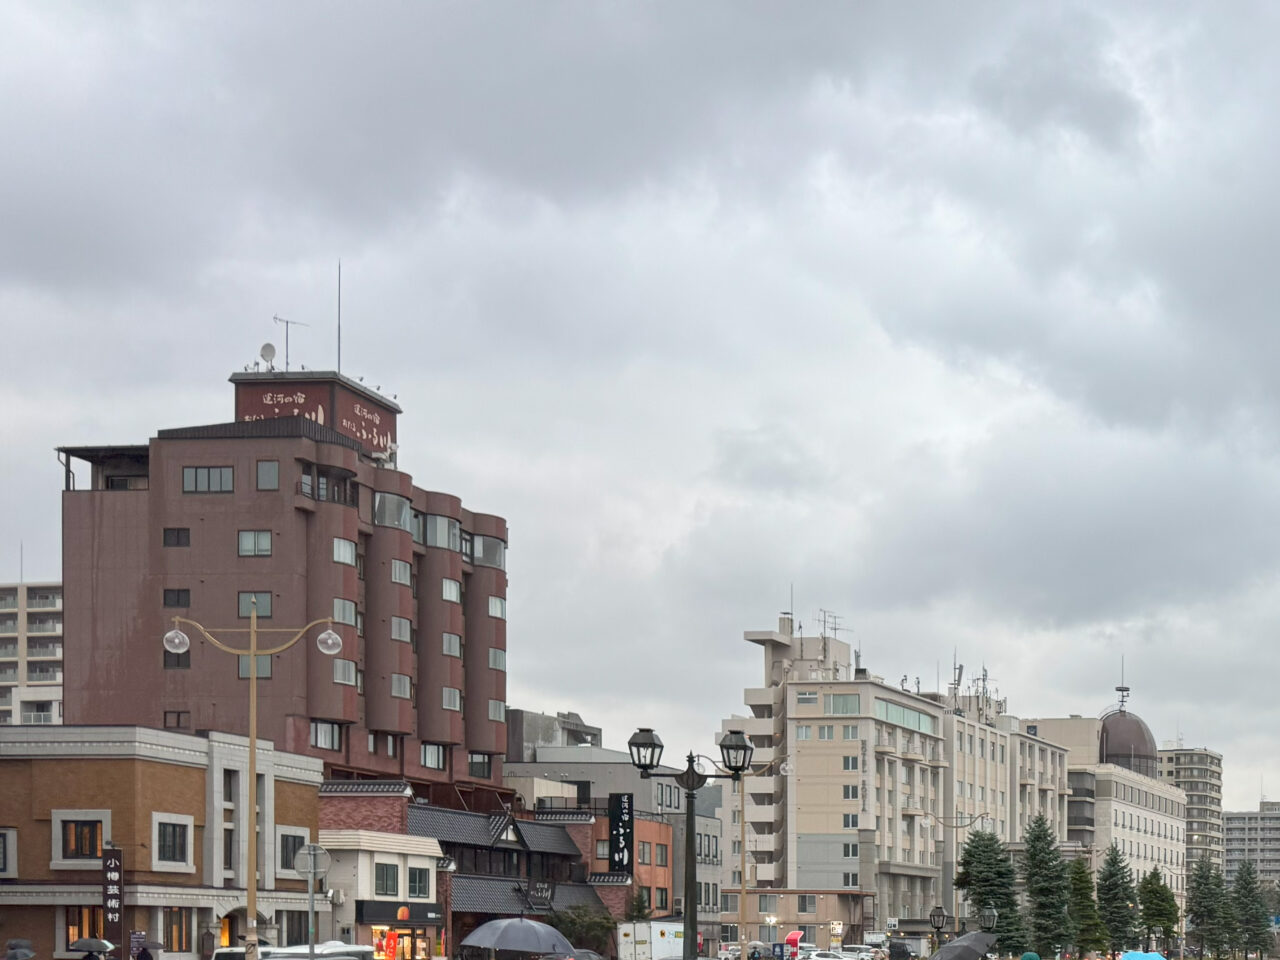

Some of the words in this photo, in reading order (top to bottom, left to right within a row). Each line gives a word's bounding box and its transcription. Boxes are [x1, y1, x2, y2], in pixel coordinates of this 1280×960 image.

[107, 858, 120, 922] 小樽芸術村
[387, 939, 394, 956] うに
